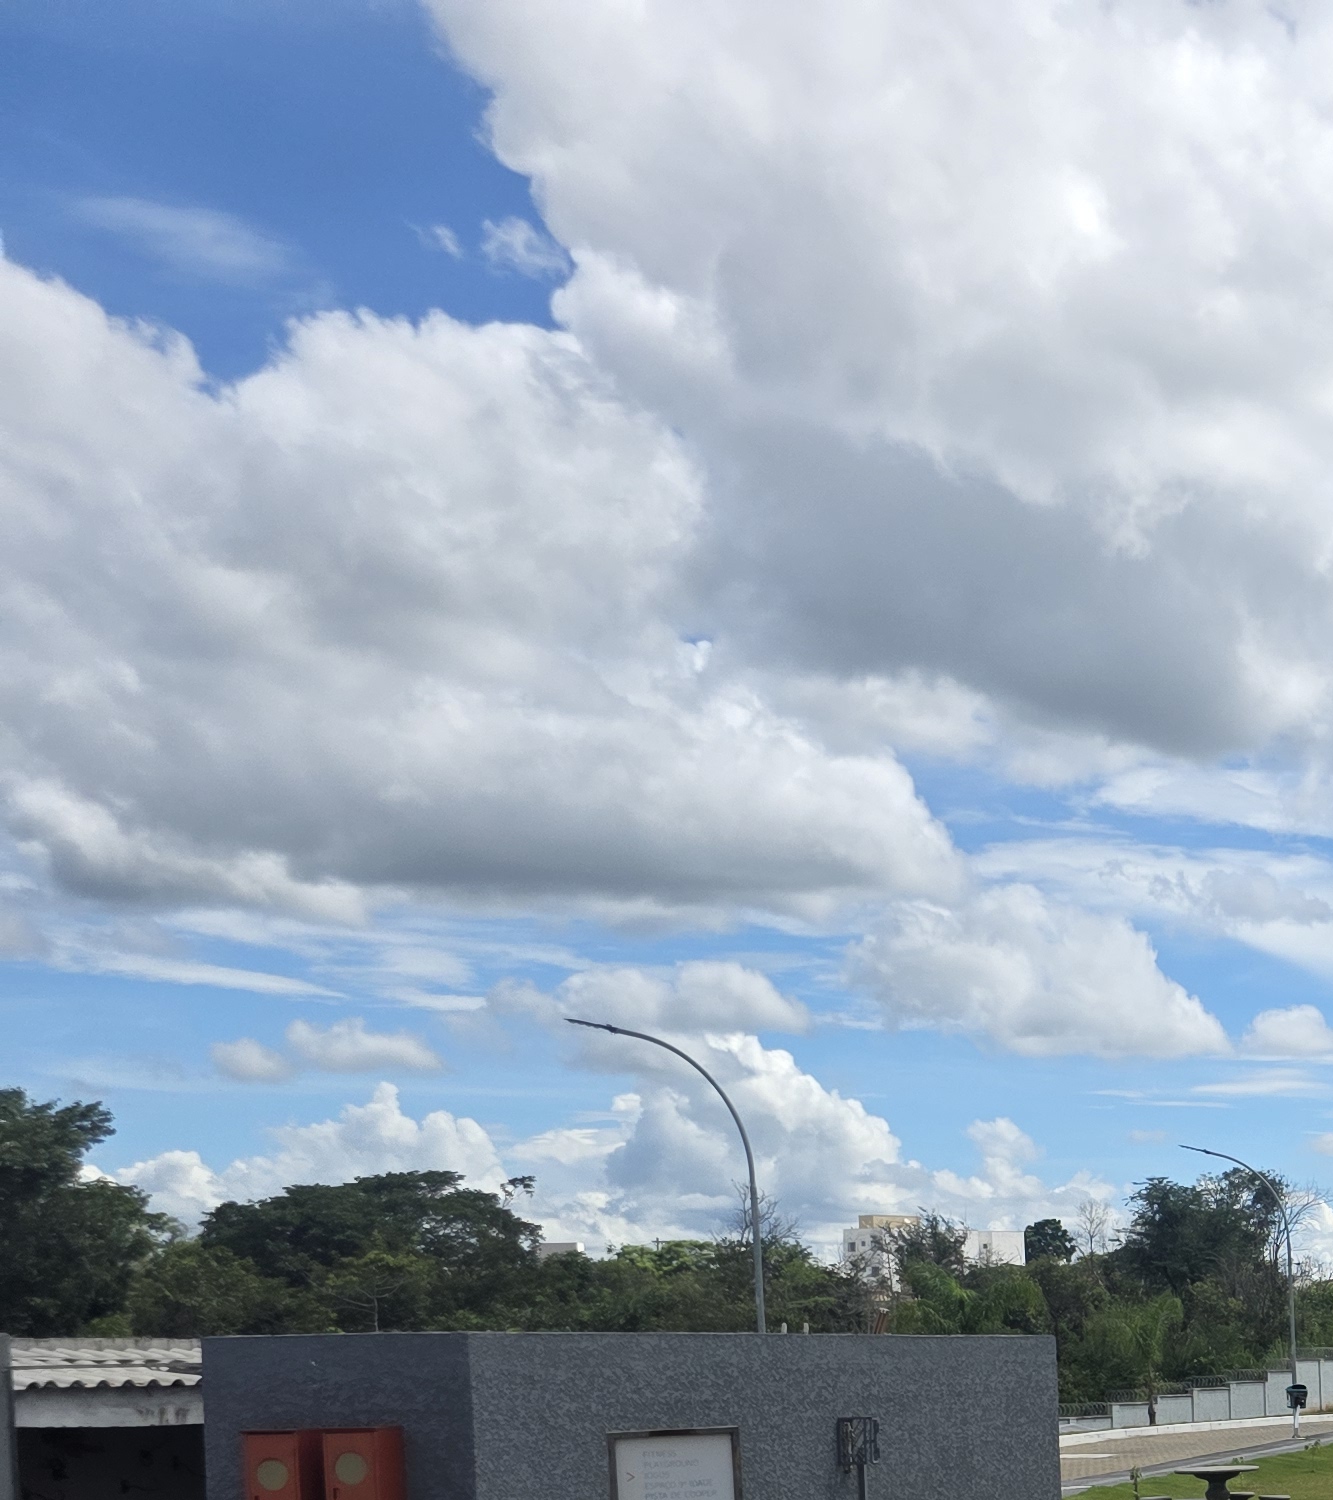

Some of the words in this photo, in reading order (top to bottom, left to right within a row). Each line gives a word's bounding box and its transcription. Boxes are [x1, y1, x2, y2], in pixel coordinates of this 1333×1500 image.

[642, 1450, 677, 1458] FITNESS
[643, 1459, 699, 1469] PLAYGROUND
[644, 1481, 676, 1490] ESPAÇO
[689, 1479, 713, 1488] IDADE
[645, 1491, 668, 1500] PISTA
[671, 1490, 681, 1499] DE
[685, 1489, 718, 1498] COOPER
